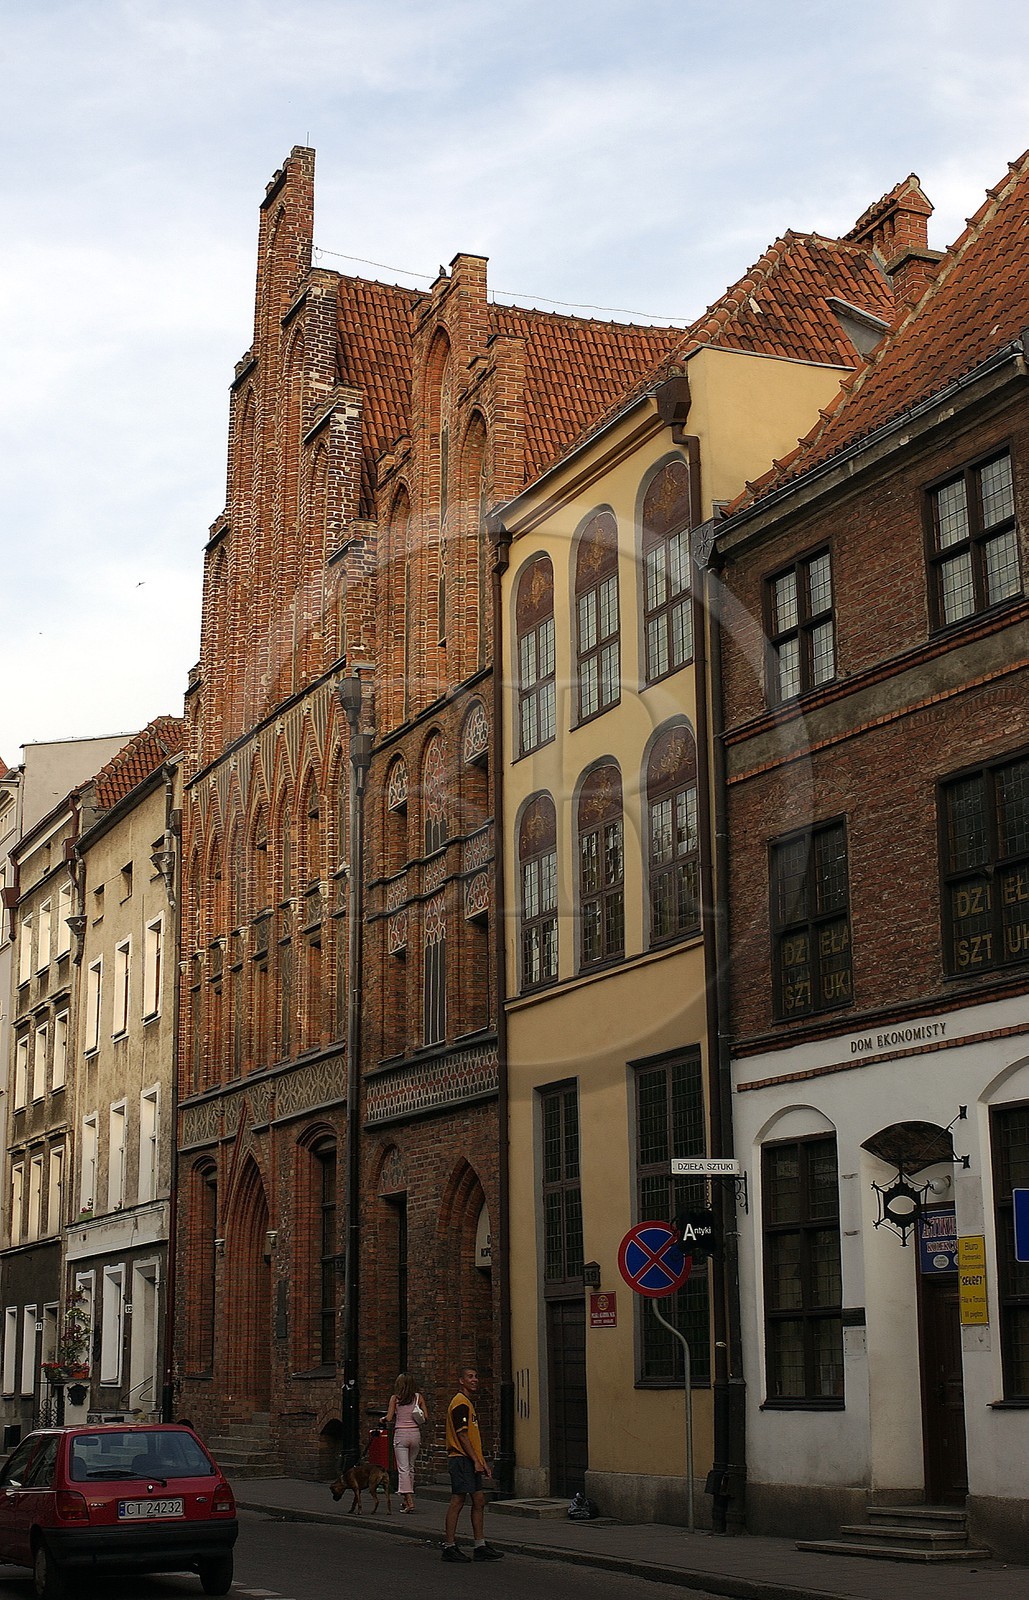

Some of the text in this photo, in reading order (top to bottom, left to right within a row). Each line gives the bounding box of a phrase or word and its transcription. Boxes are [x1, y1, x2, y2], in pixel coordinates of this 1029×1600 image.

[850, 1022, 947, 1054] DOM EKONOMISTY
[677, 1162, 734, 1171] DZIEŁA SZTUKI
[682, 1223, 712, 1241] Antyki
[127, 1502, 143, 1515] CT
[147, 1501, 181, 1514] 24232
